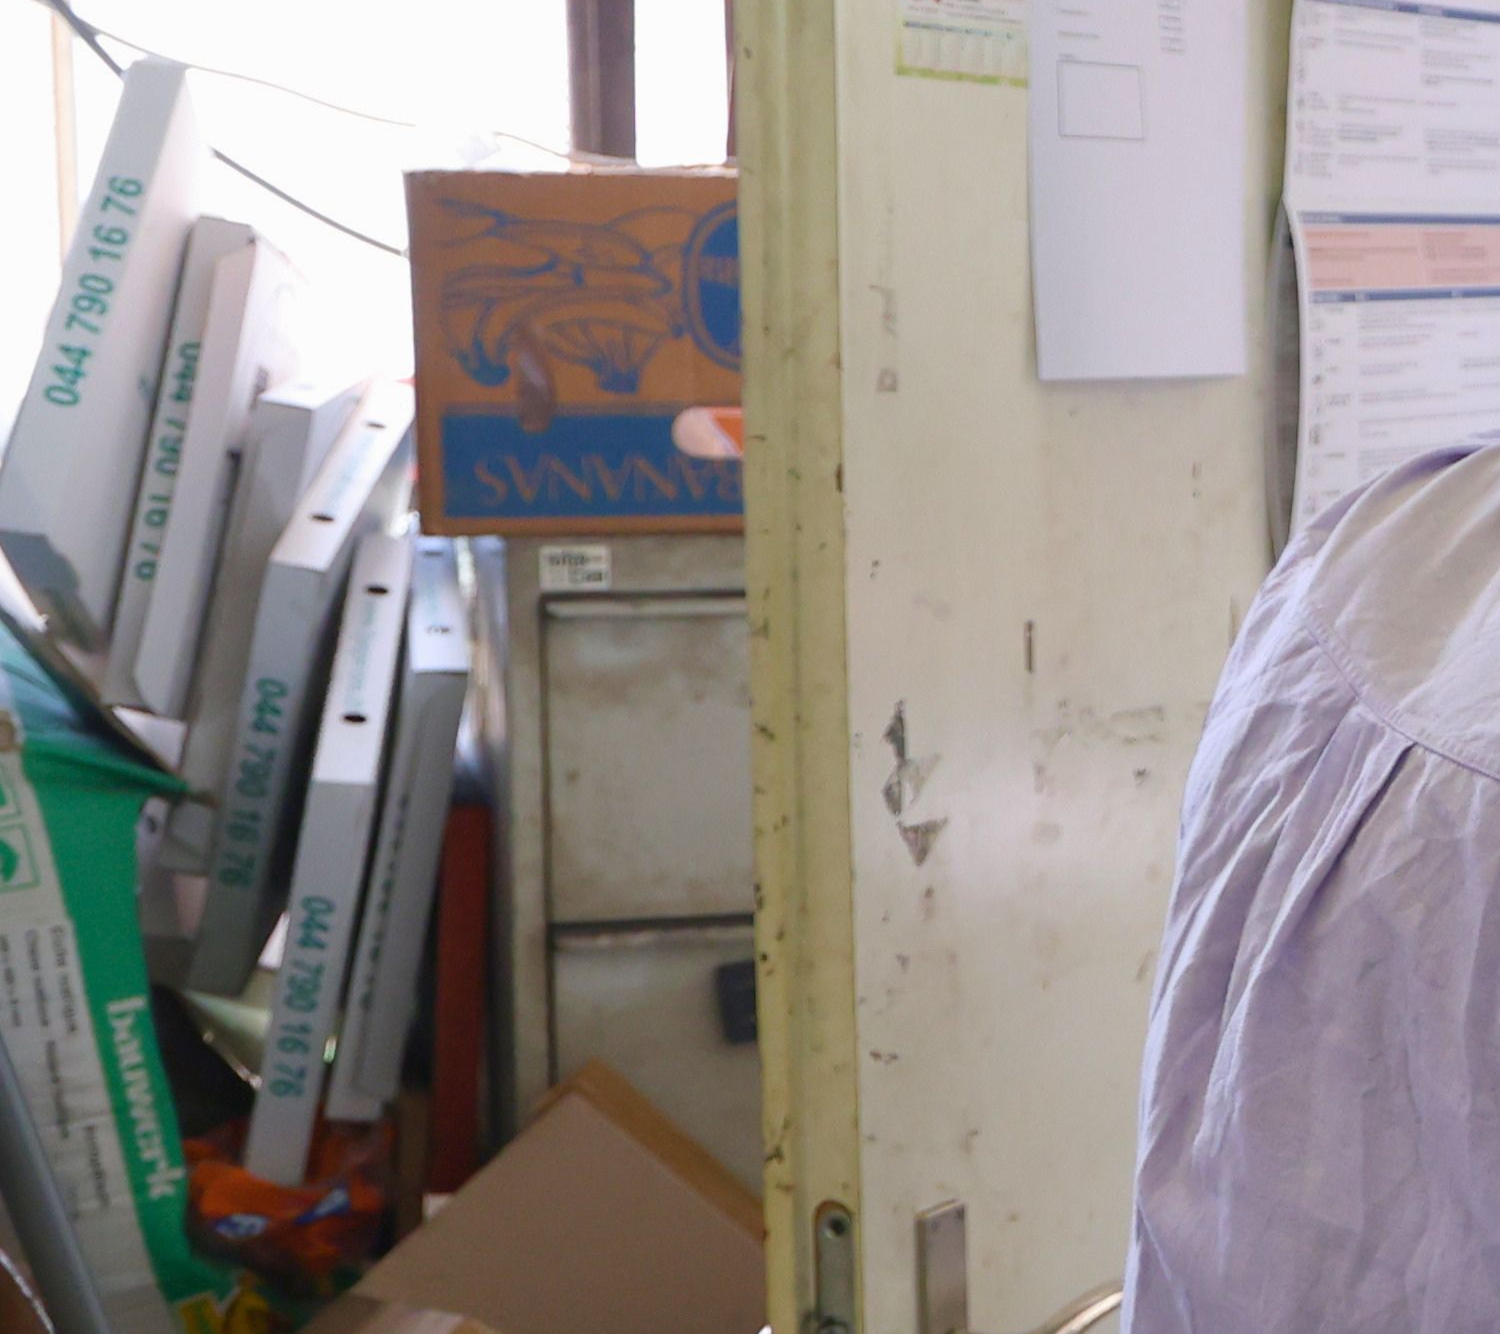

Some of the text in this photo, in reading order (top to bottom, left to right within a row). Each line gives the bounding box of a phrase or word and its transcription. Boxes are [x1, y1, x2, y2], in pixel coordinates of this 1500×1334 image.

[43, 174, 146, 409] 044 790 16 76
[472, 453, 743, 509] BANANAS
[215, 676, 289, 892] 044 790 16 76
[106, 995, 183, 1200] bauwerk
[268, 894, 337, 1101] 044 790 16 76
